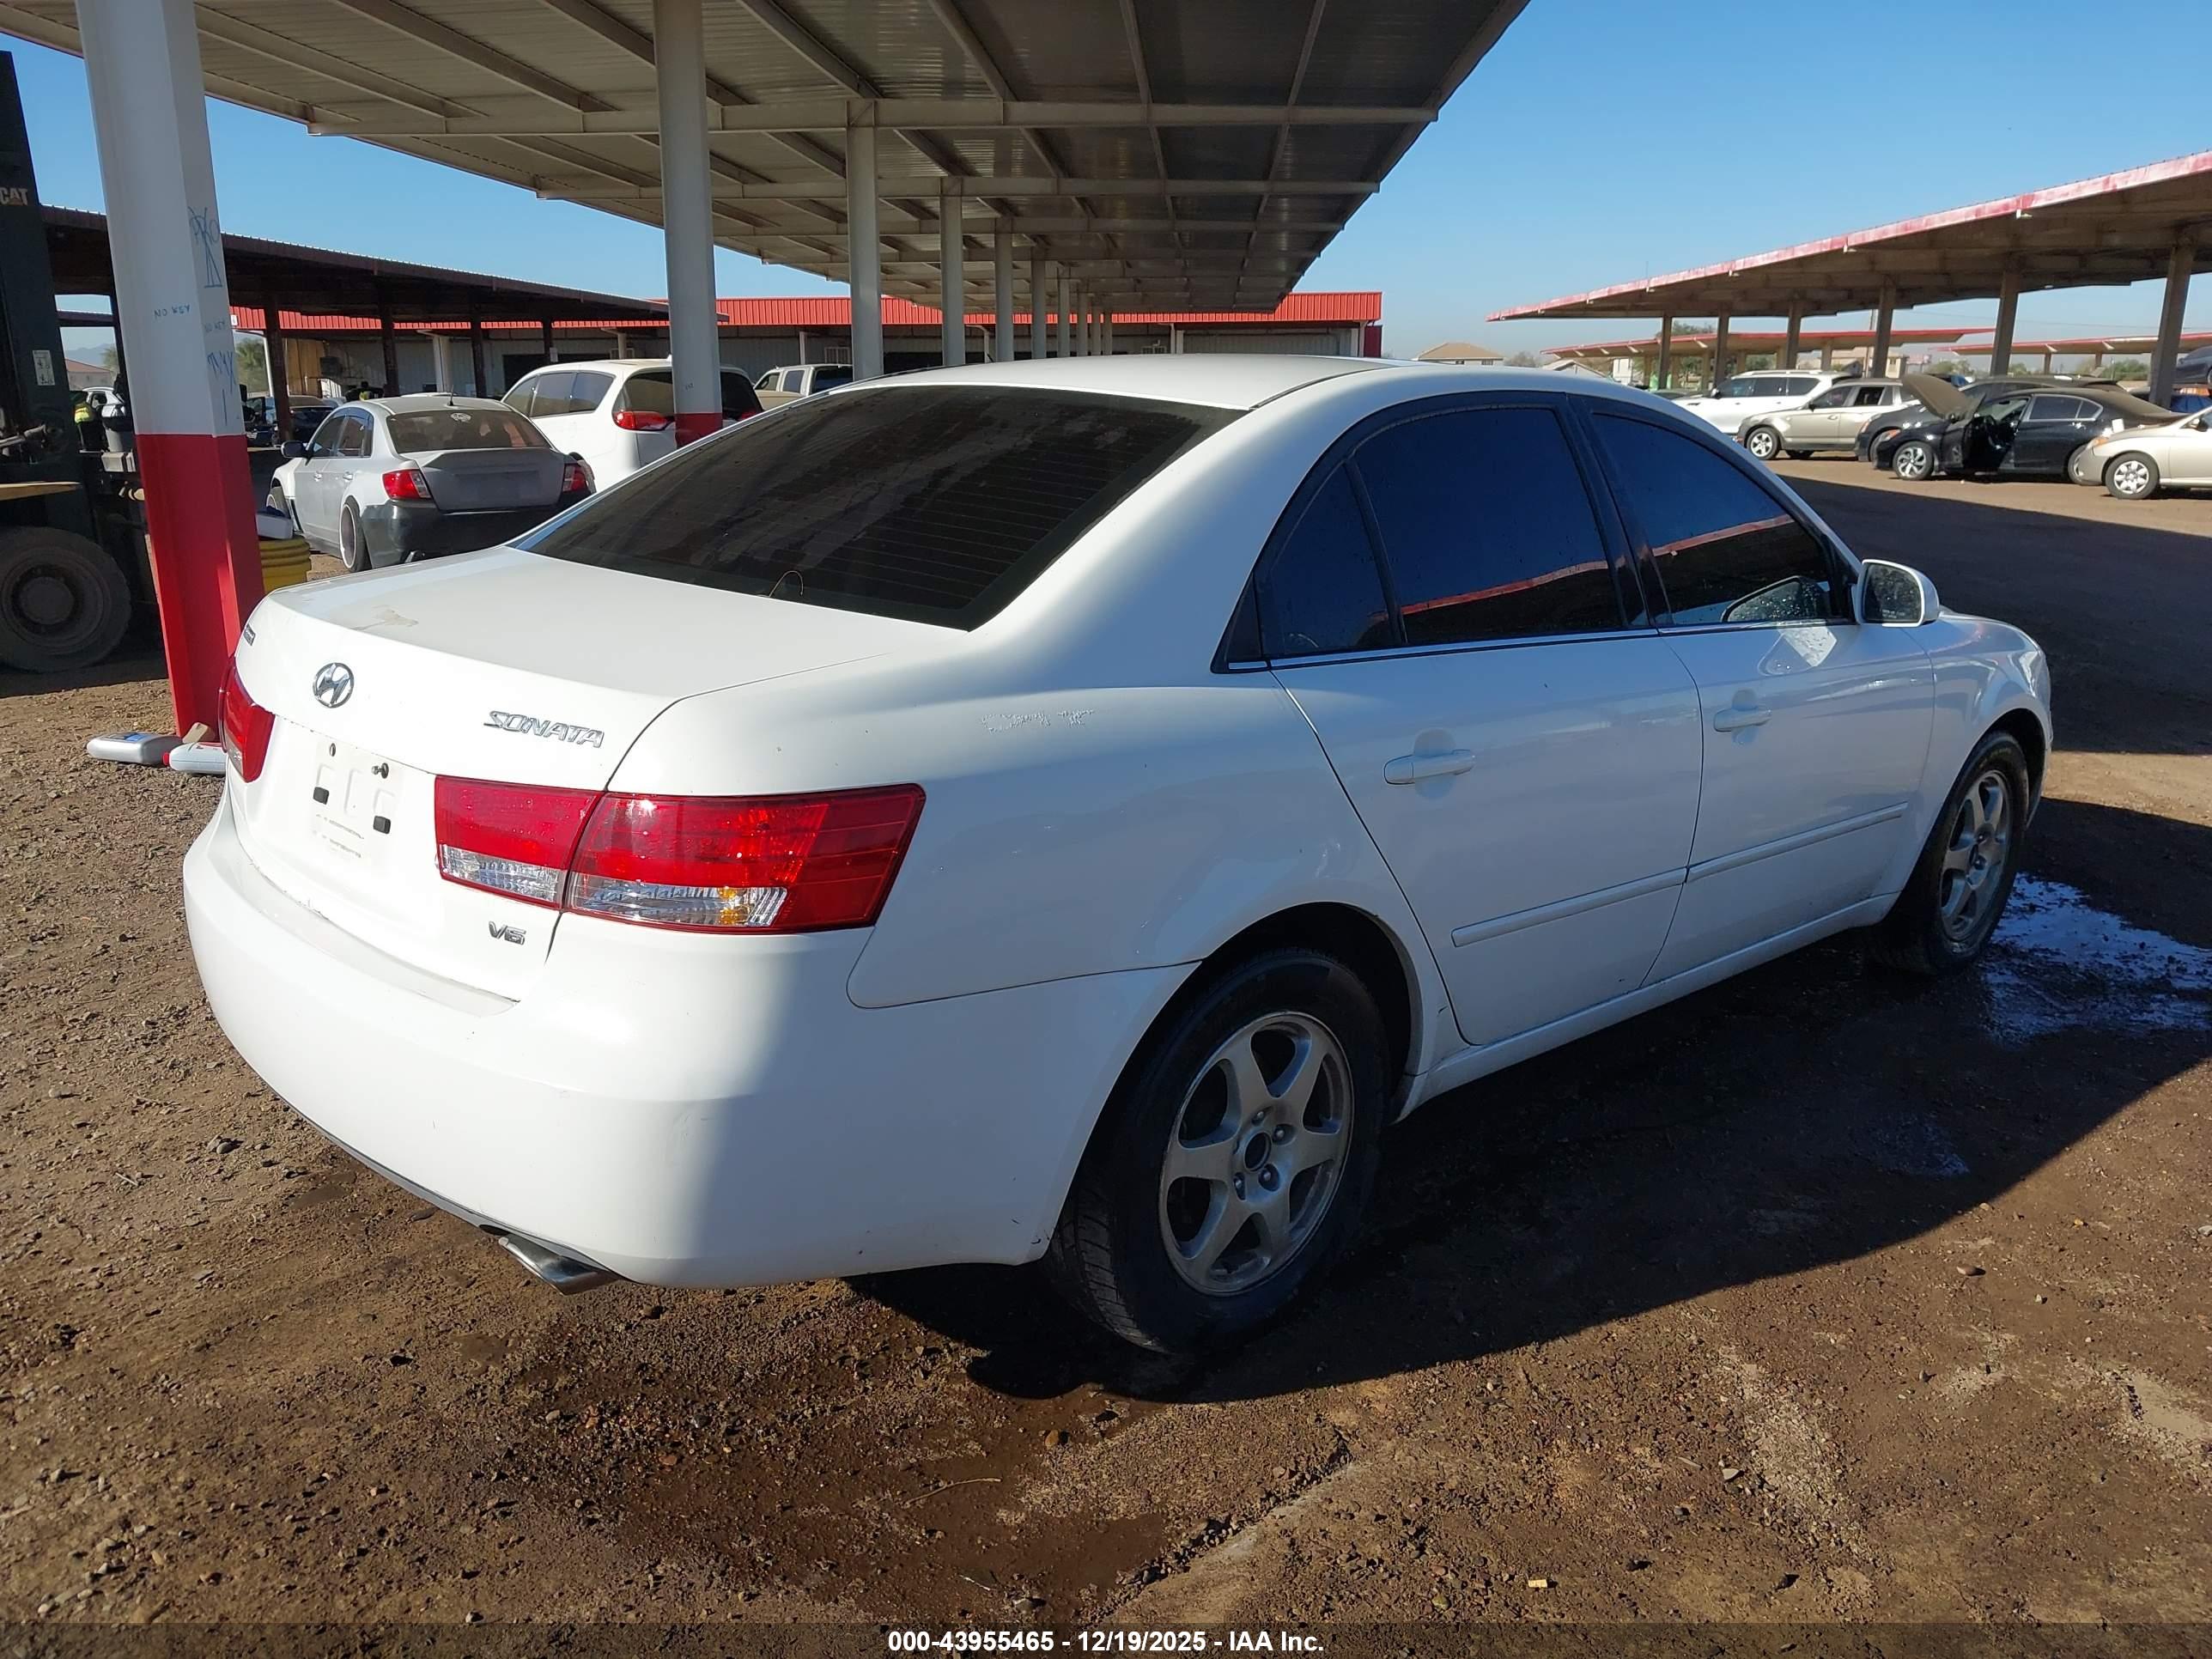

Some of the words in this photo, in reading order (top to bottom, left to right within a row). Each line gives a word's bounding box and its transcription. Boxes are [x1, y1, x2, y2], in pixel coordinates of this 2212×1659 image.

[0, 187, 28, 206] CAT
[154, 308, 168, 319] NO
[171, 304, 191, 314] KEY
[483, 710, 605, 749] SONATA
[488, 920, 527, 946] V6
